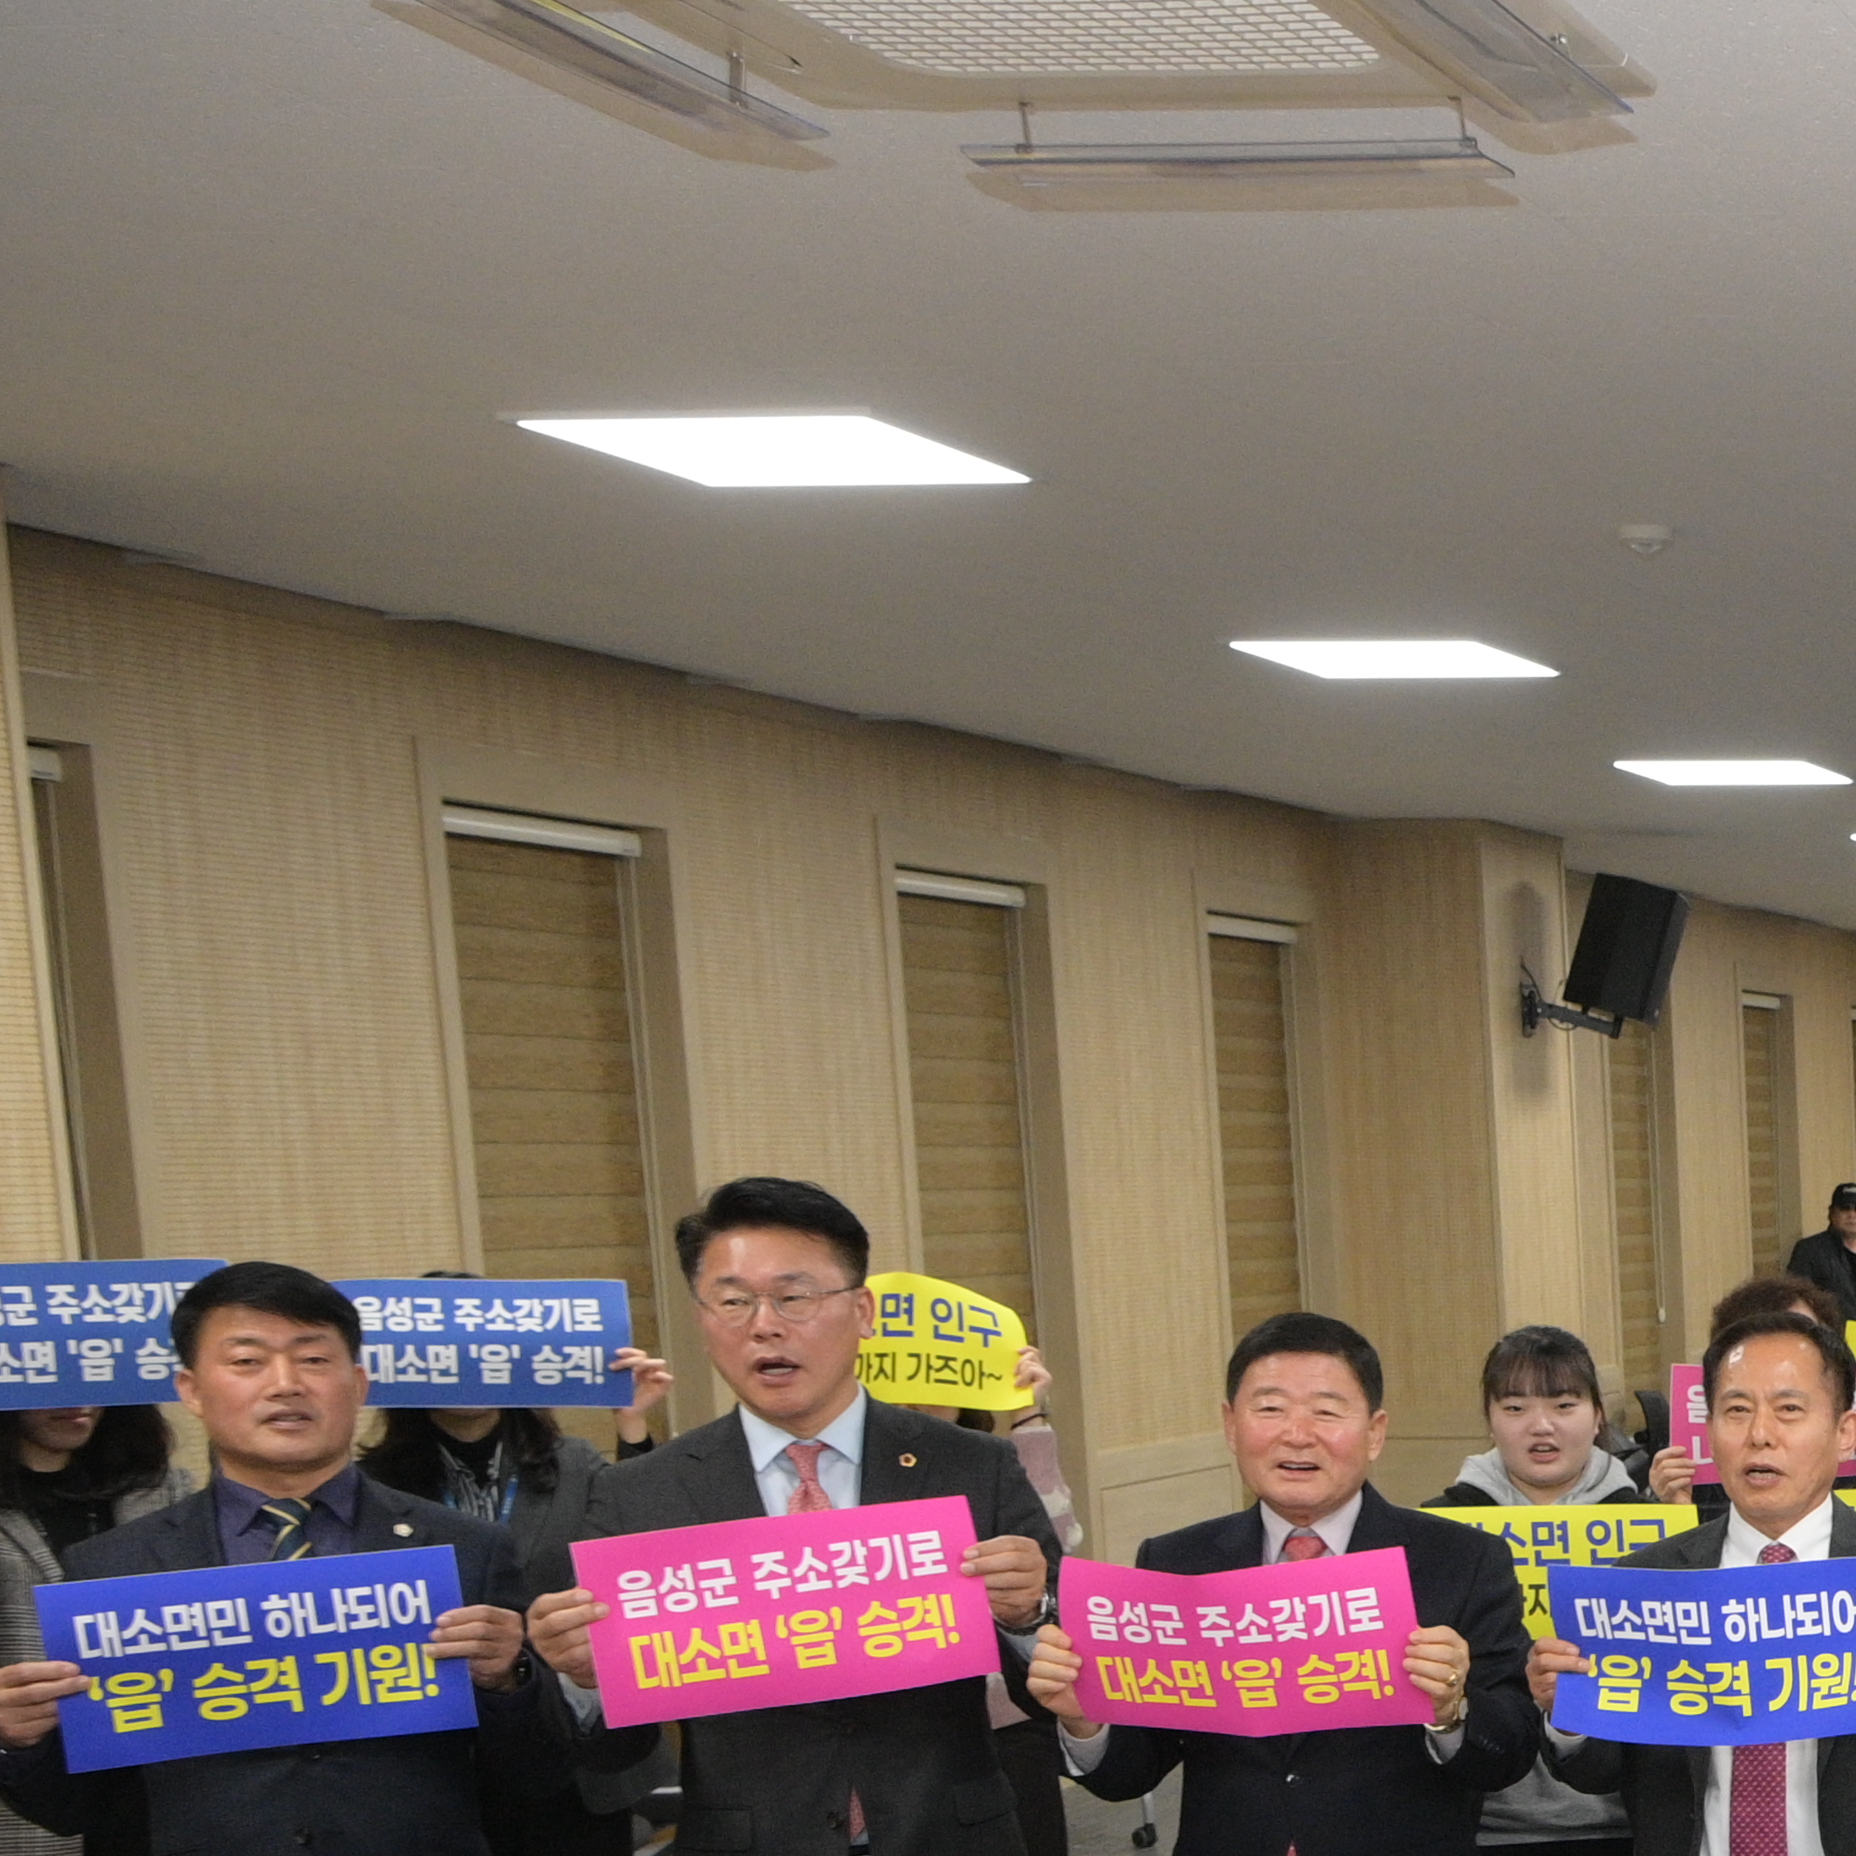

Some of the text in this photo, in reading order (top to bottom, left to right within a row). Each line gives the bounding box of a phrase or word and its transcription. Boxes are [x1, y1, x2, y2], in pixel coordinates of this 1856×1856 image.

[352, 1296, 604, 1332] 음성군 주소갖기로
[362, 1344, 459, 1384] 대소면
[532, 1345, 604, 1384] 승격!
[617, 1529, 948, 1619] 음성군 주소갖기로
[74, 1581, 431, 1660] 대소면민 하나되어
[628, 1619, 770, 1691] 대소면
[857, 1593, 960, 1659] 승격!
[1086, 1587, 1384, 1648] 음성군 주소갖기로
[1574, 1598, 1712, 1645] 대소면민
[193, 1657, 304, 1722] 승격
[323, 1642, 438, 1706] 기원!
[1096, 1655, 1217, 1707] 대소면
[1297, 1649, 1394, 1704] 승격!
[1666, 1659, 1752, 1717] 승격
